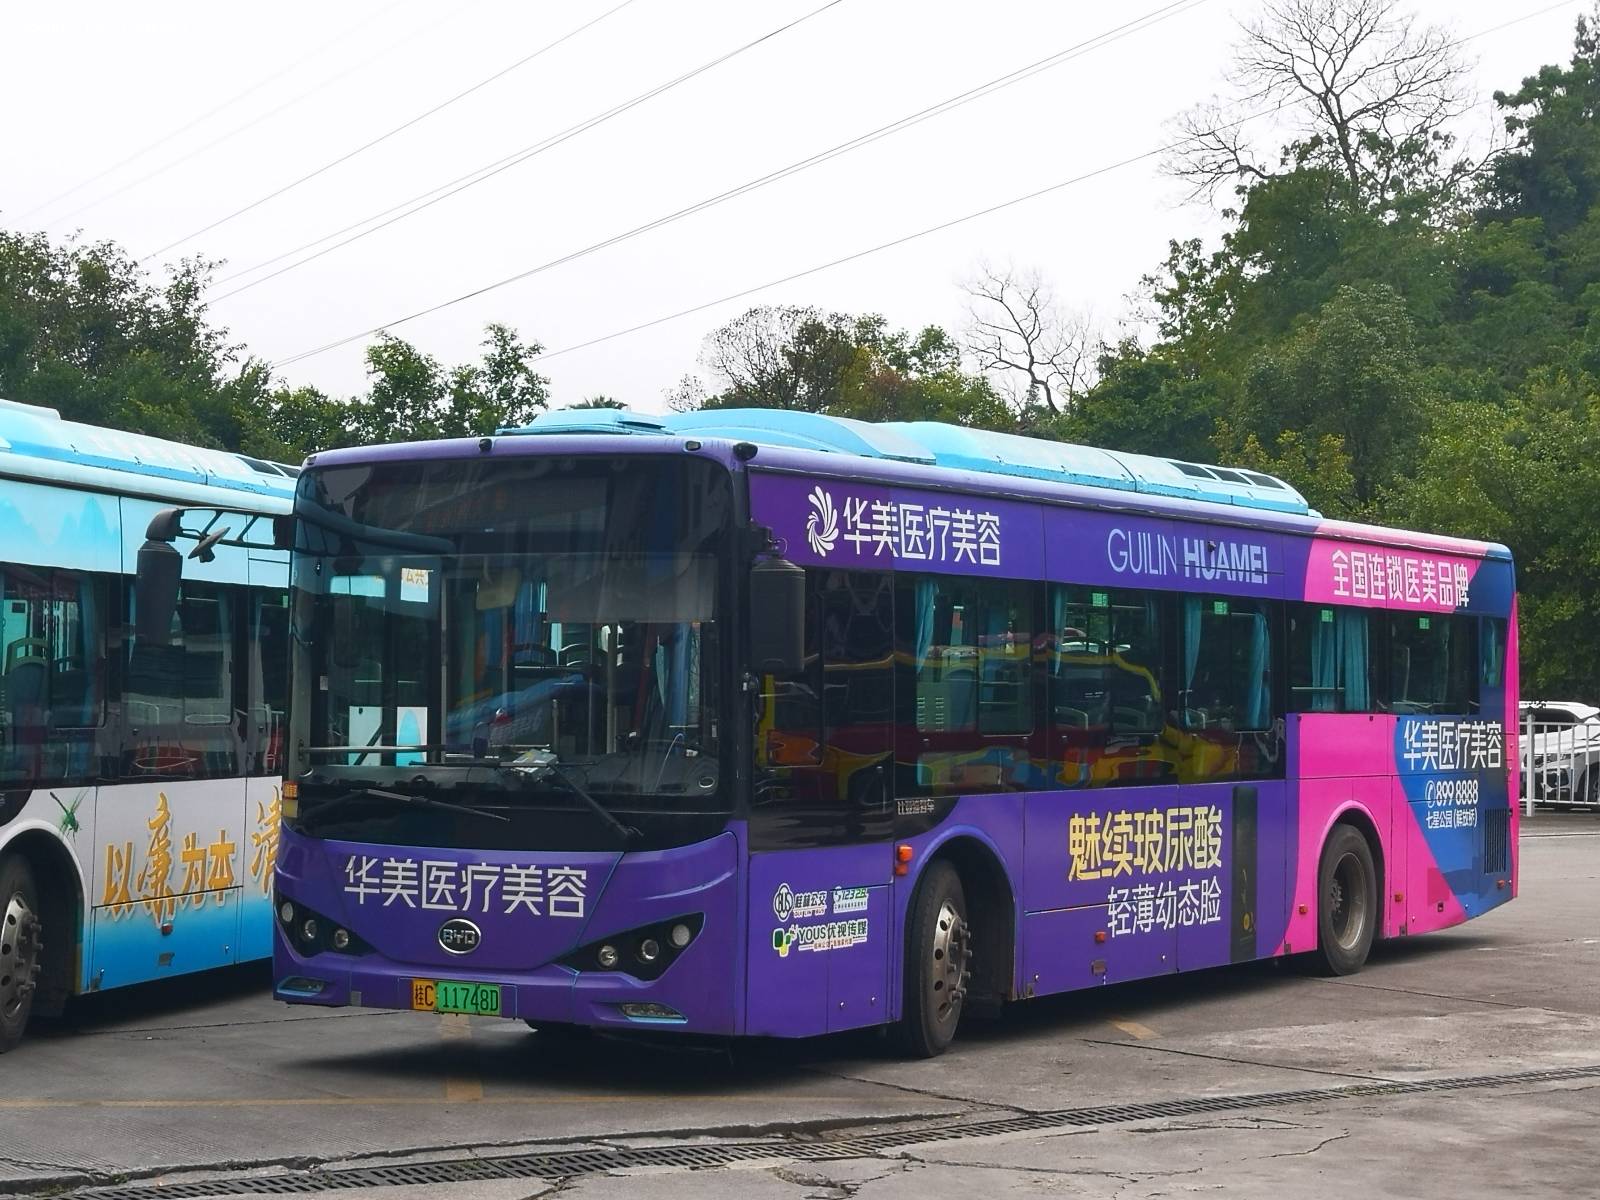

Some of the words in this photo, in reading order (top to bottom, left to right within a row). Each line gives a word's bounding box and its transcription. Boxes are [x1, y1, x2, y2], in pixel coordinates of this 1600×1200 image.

[844, 496, 1001, 566] 华美医疗美容
[1107, 528, 1178, 577] GUILIN
[1183, 536, 1268, 585] HUAMEI
[1332, 550, 1470, 607] 全国连锁医美品牌
[1403, 720, 1502, 770] 华美医疗美容
[1436, 780, 1454, 806] 899
[1456, 779, 1479, 805] 8888
[102, 792, 237, 926] 以廉为本
[1068, 804, 1223, 882] 魅续玻尿酸
[344, 855, 588, 918] 华美医疗美容
[1108, 876, 1222, 938] 轻薄幼态脸
[443, 928, 476, 945] BYD
